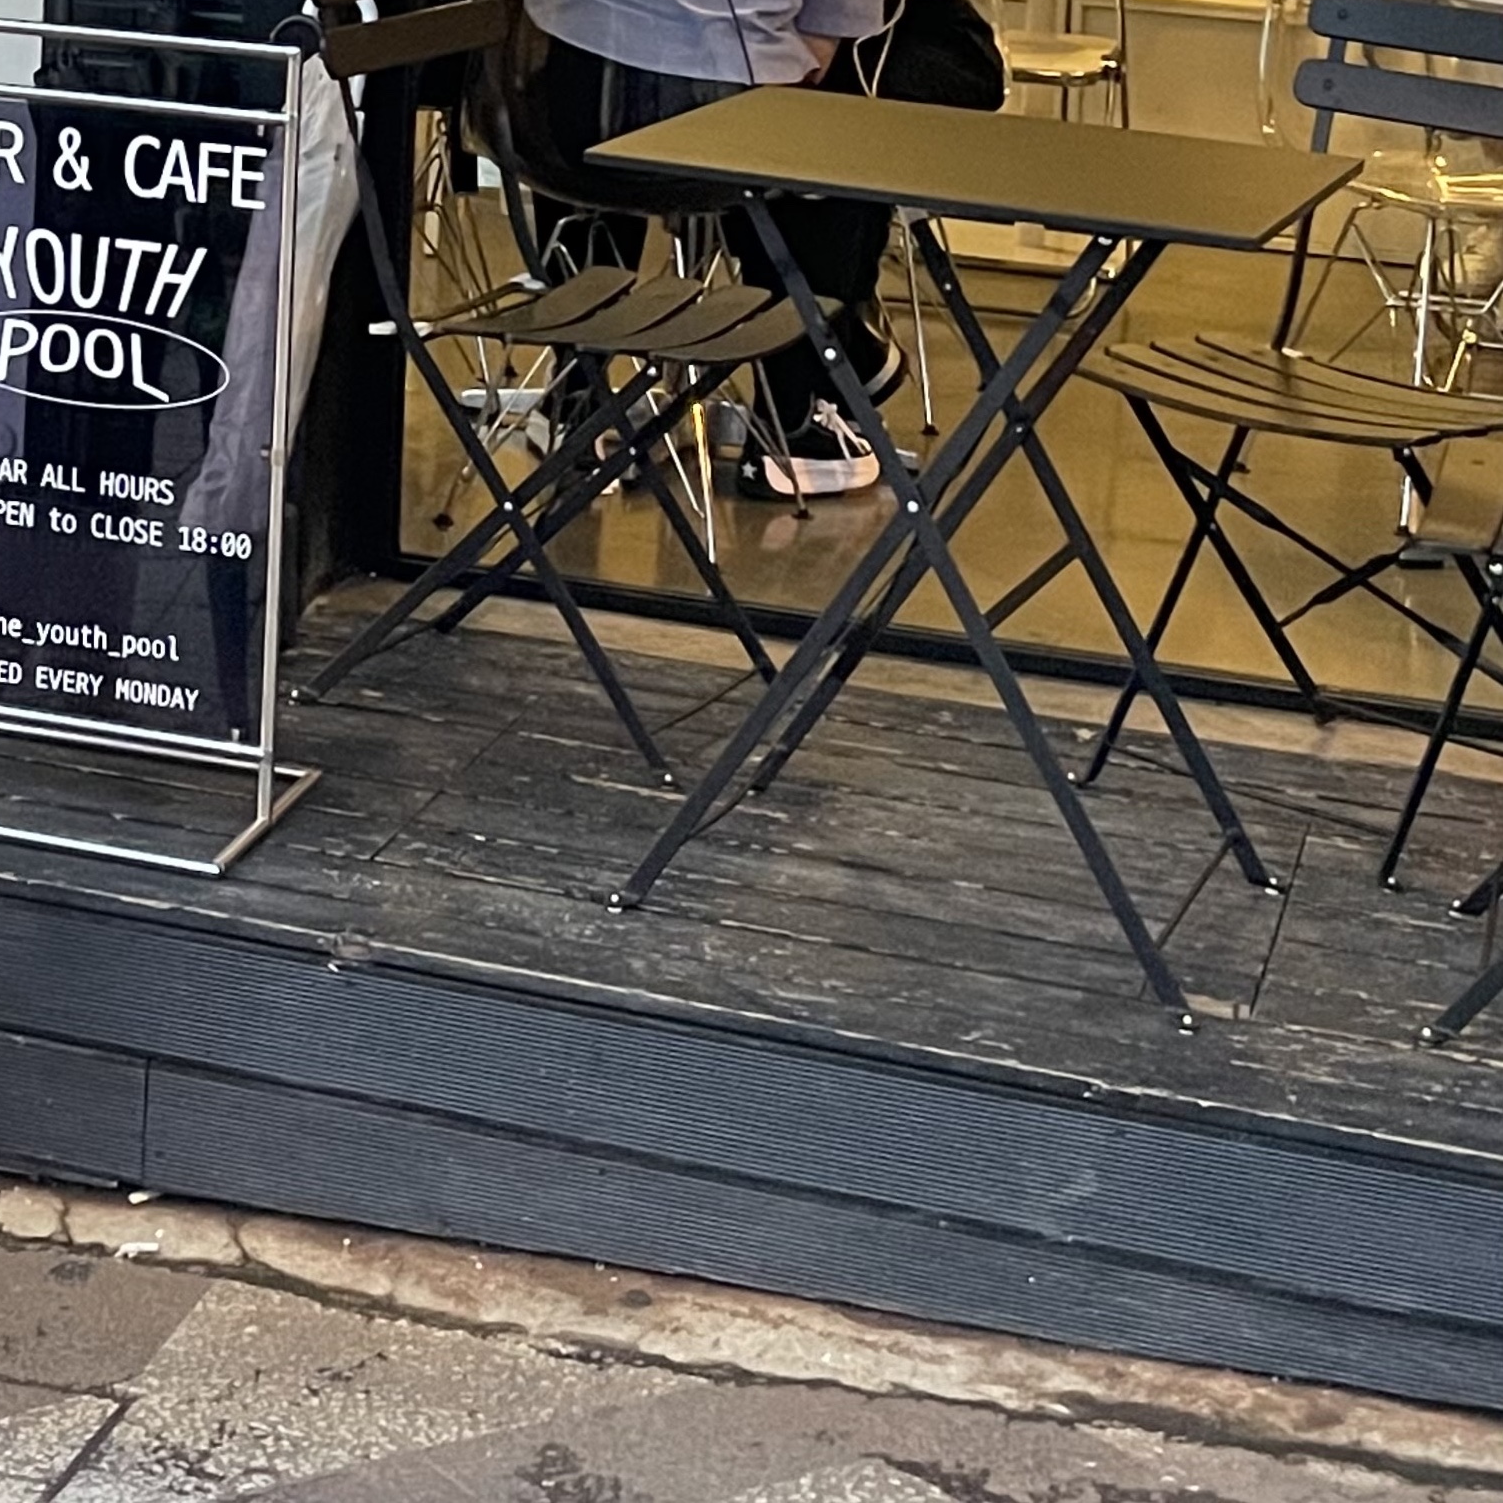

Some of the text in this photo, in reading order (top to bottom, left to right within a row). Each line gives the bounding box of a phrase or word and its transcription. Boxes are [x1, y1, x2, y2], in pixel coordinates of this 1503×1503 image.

[52, 126, 93, 191] &
[123, 134, 268, 210] CAFE
[40, 463, 86, 494] ALL
[99, 471, 175, 506] HOURS
[48, 507, 77, 535] to
[90, 512, 164, 548] CLOSE
[178, 526, 253, 560] 18:00
[35, 666, 104, 697] EVERY
[114, 677, 200, 712] MONDAY
